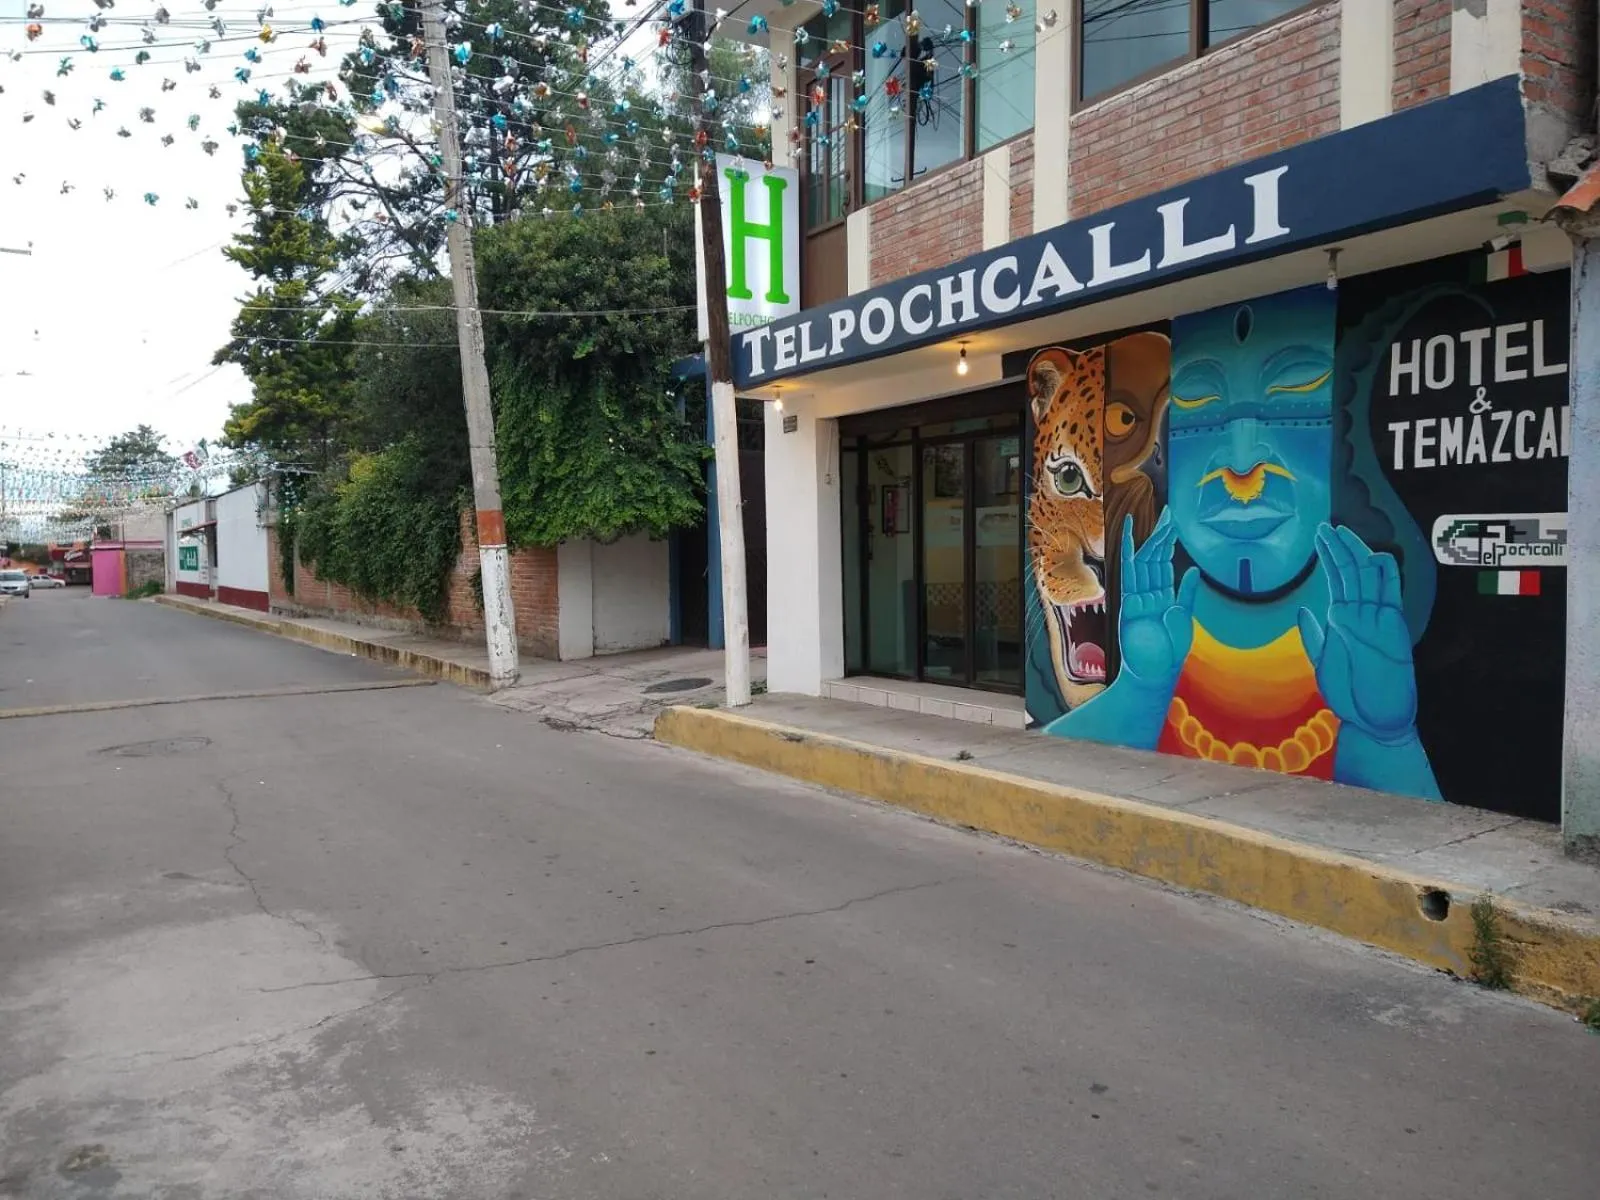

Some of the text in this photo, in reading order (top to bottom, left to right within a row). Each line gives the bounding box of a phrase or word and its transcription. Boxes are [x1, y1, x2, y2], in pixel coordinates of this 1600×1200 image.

[724, 168, 790, 304] H
[741, 165, 1291, 378] TELPOCHCALLI
[1389, 319, 1568, 396] HOTEL
[1469, 386, 1492, 414] &
